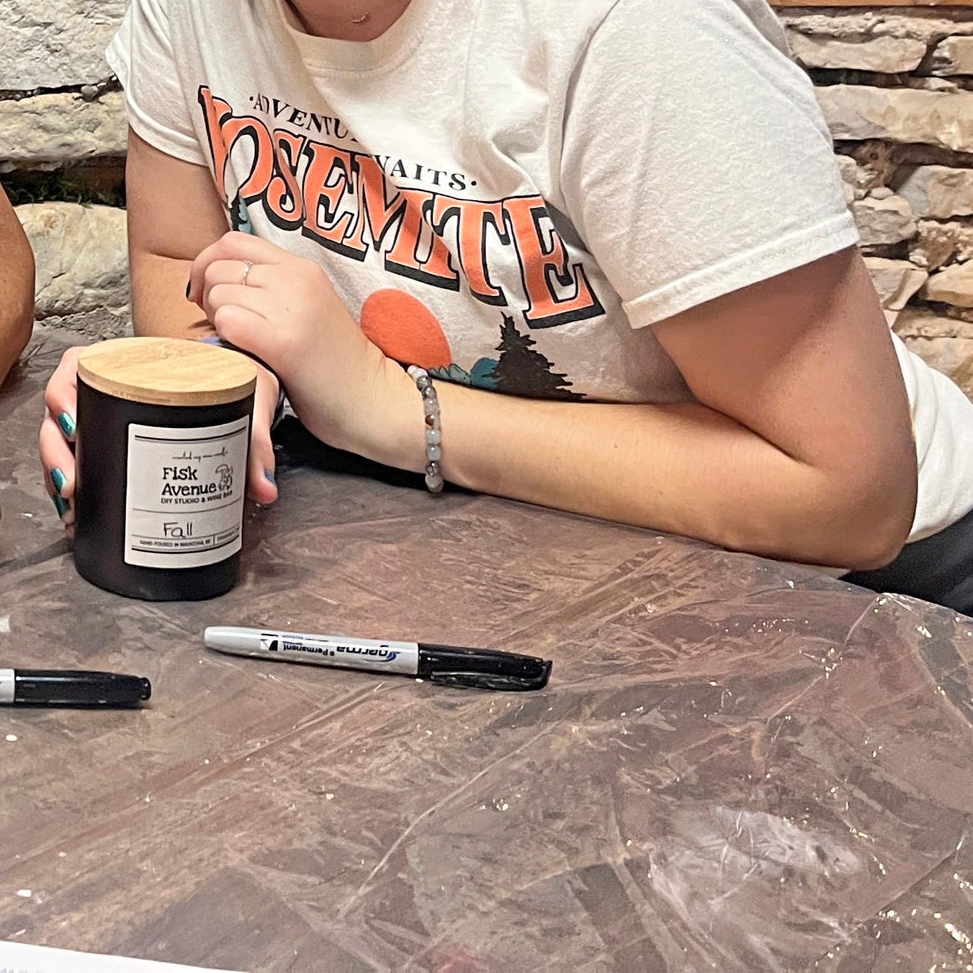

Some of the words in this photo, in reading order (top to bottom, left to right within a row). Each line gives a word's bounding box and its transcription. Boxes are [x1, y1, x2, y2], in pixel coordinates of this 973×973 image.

[252, 92, 358, 142] ADVENTU
[162, 465, 198, 481] Fisk
[161, 482, 217, 496] Avenue
[162, 522, 193, 538] Fall
[283, 643, 330, 656] Permanent
